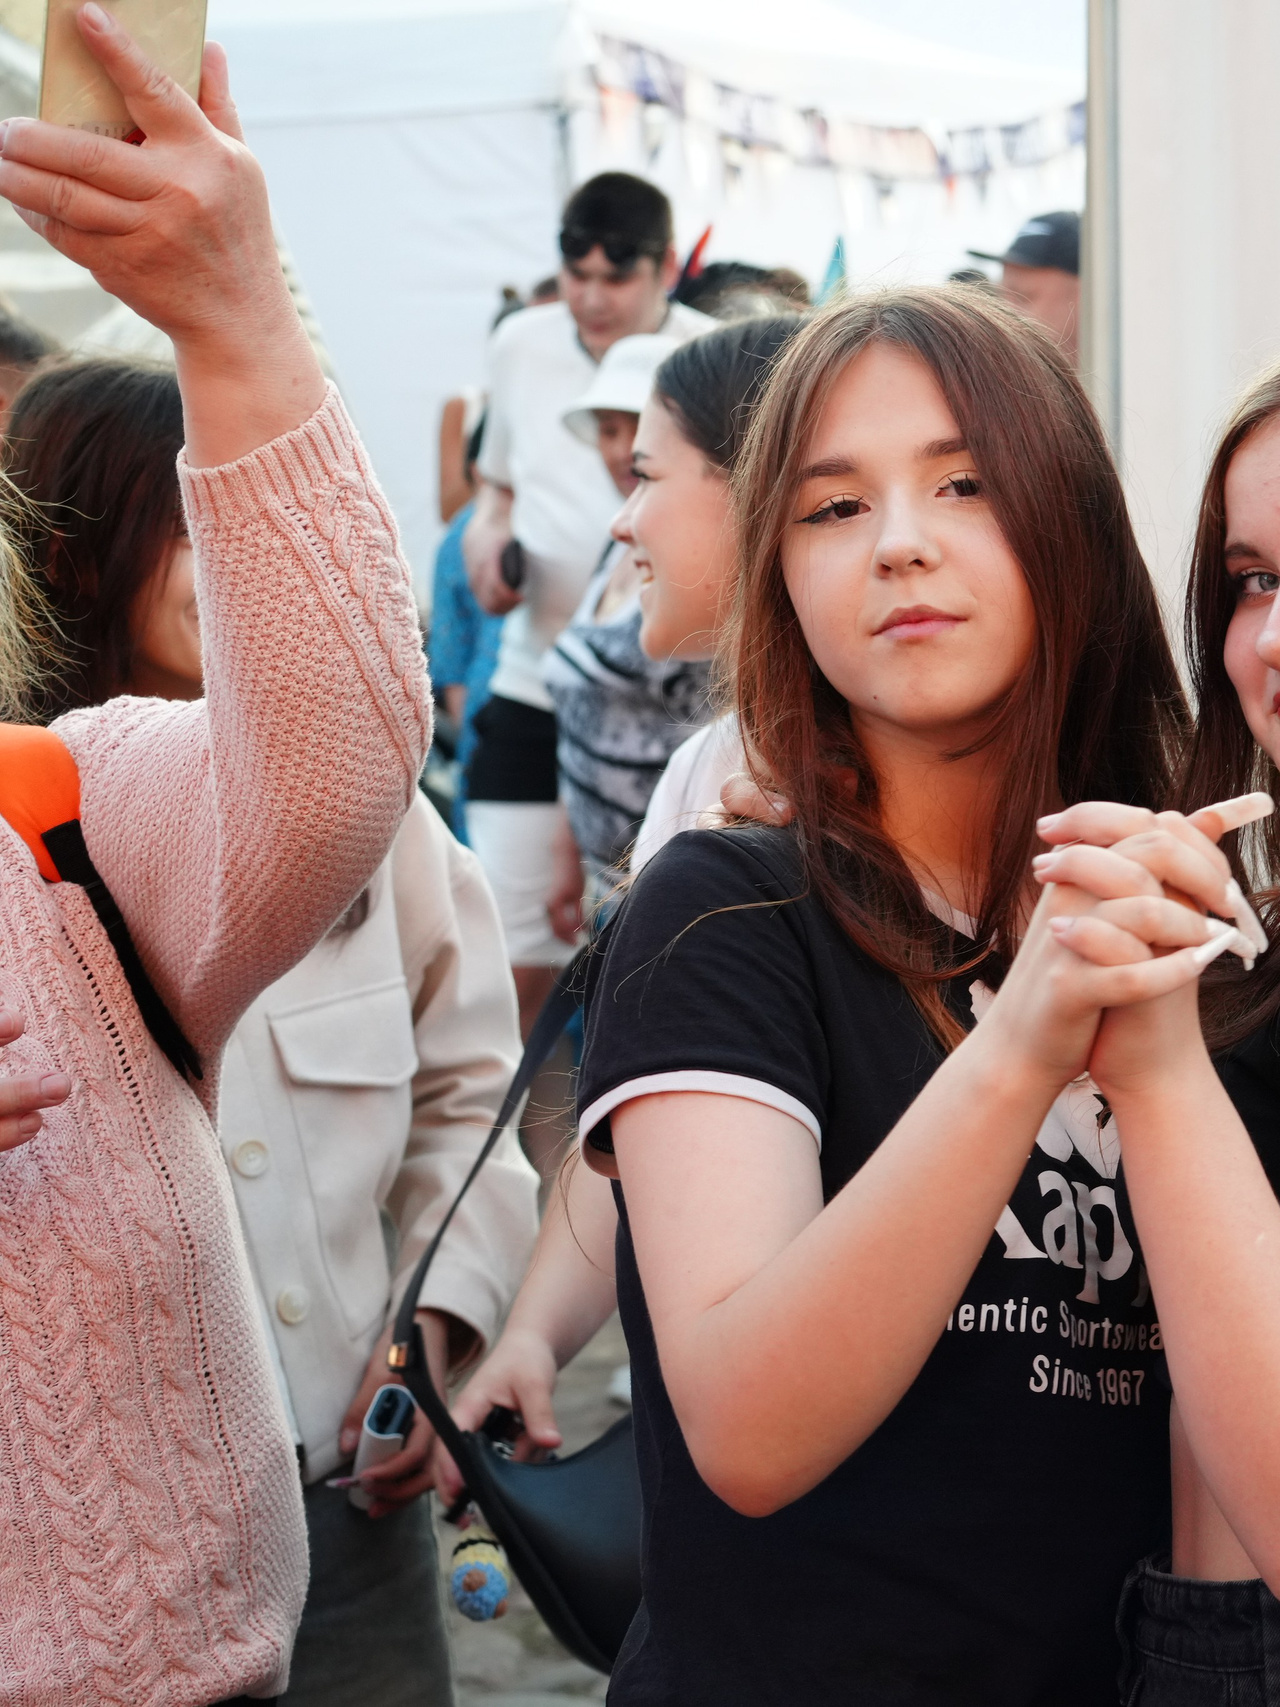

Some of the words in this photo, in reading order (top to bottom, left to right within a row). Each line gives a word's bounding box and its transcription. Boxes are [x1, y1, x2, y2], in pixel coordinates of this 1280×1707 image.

[993, 1169, 1150, 1306] ap
[946, 1296, 1048, 1333] entic
[1029, 1354, 1092, 1401] Since
[1096, 1368, 1145, 1406] 1967
